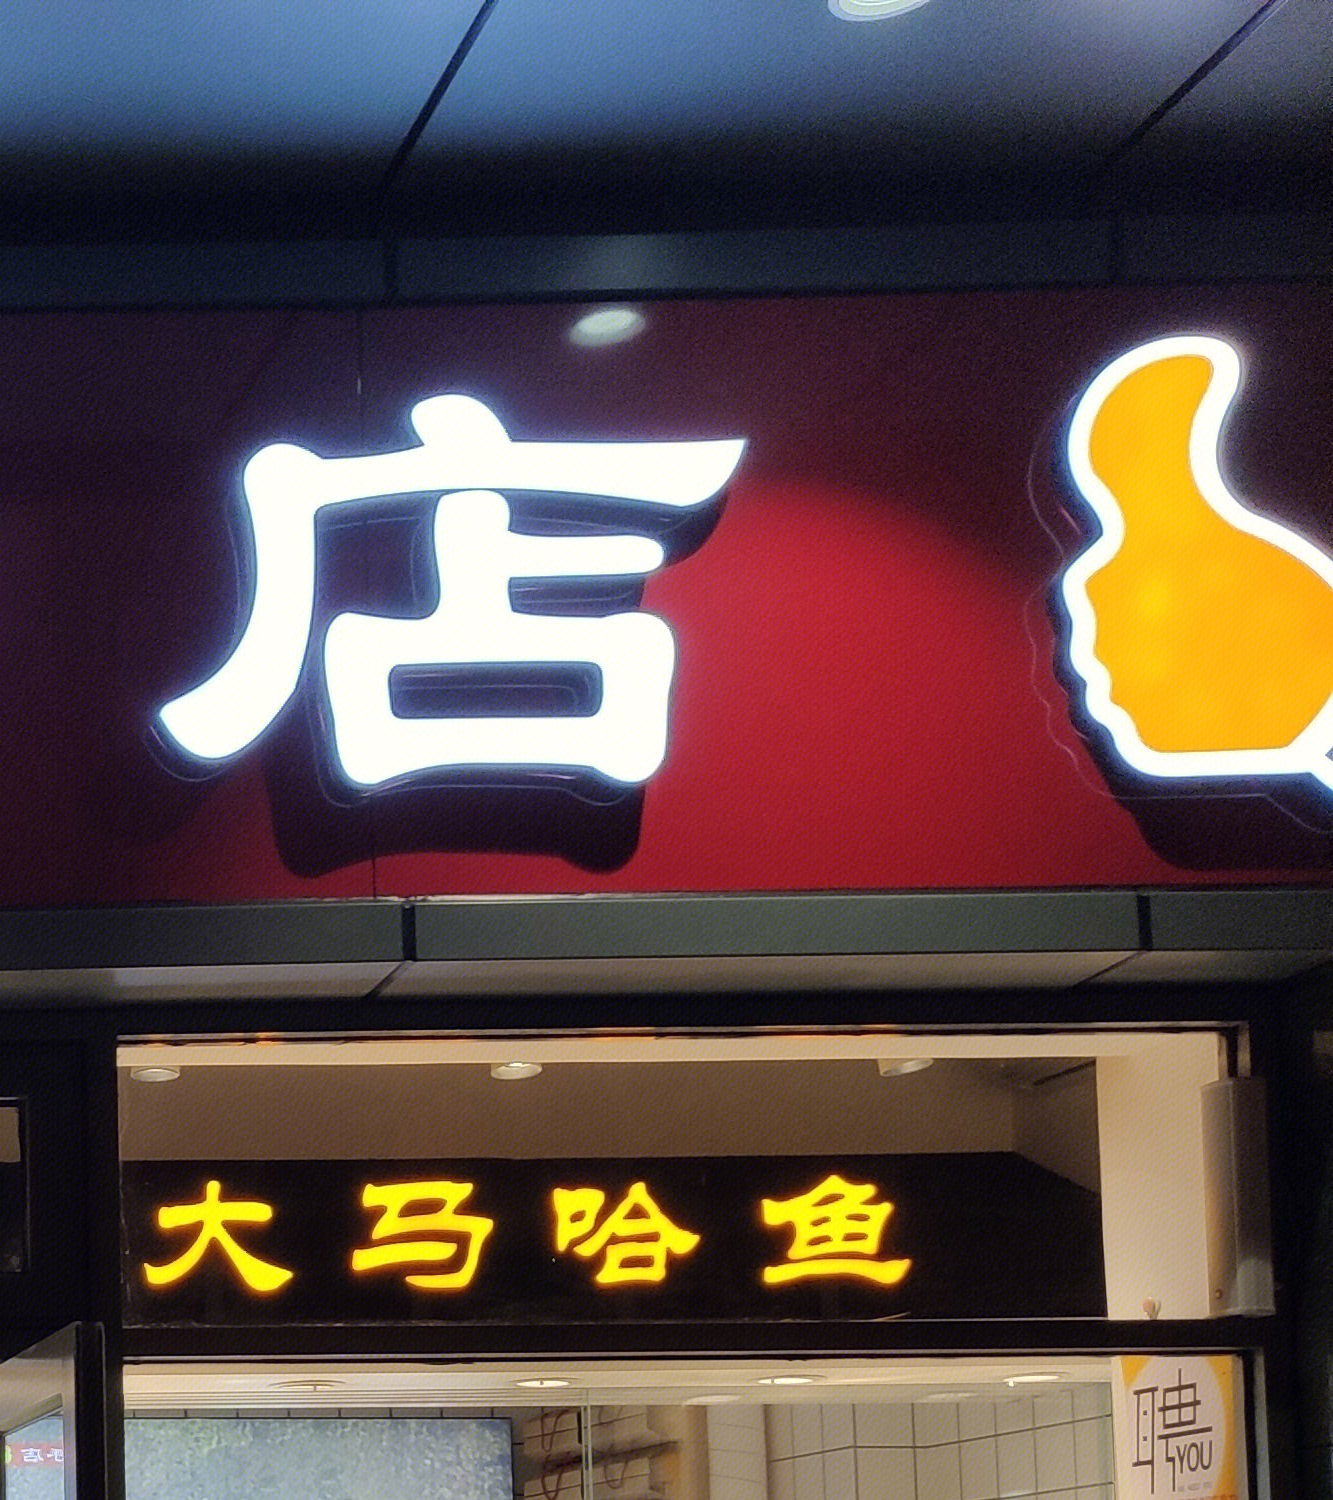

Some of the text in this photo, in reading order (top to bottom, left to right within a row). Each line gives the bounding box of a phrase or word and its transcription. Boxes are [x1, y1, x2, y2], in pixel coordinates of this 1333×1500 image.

[144, 1175, 910, 1292] 大马哈鱼
[1132, 1368, 1213, 1495] 聘
[1176, 1439, 1213, 1474] YOU
